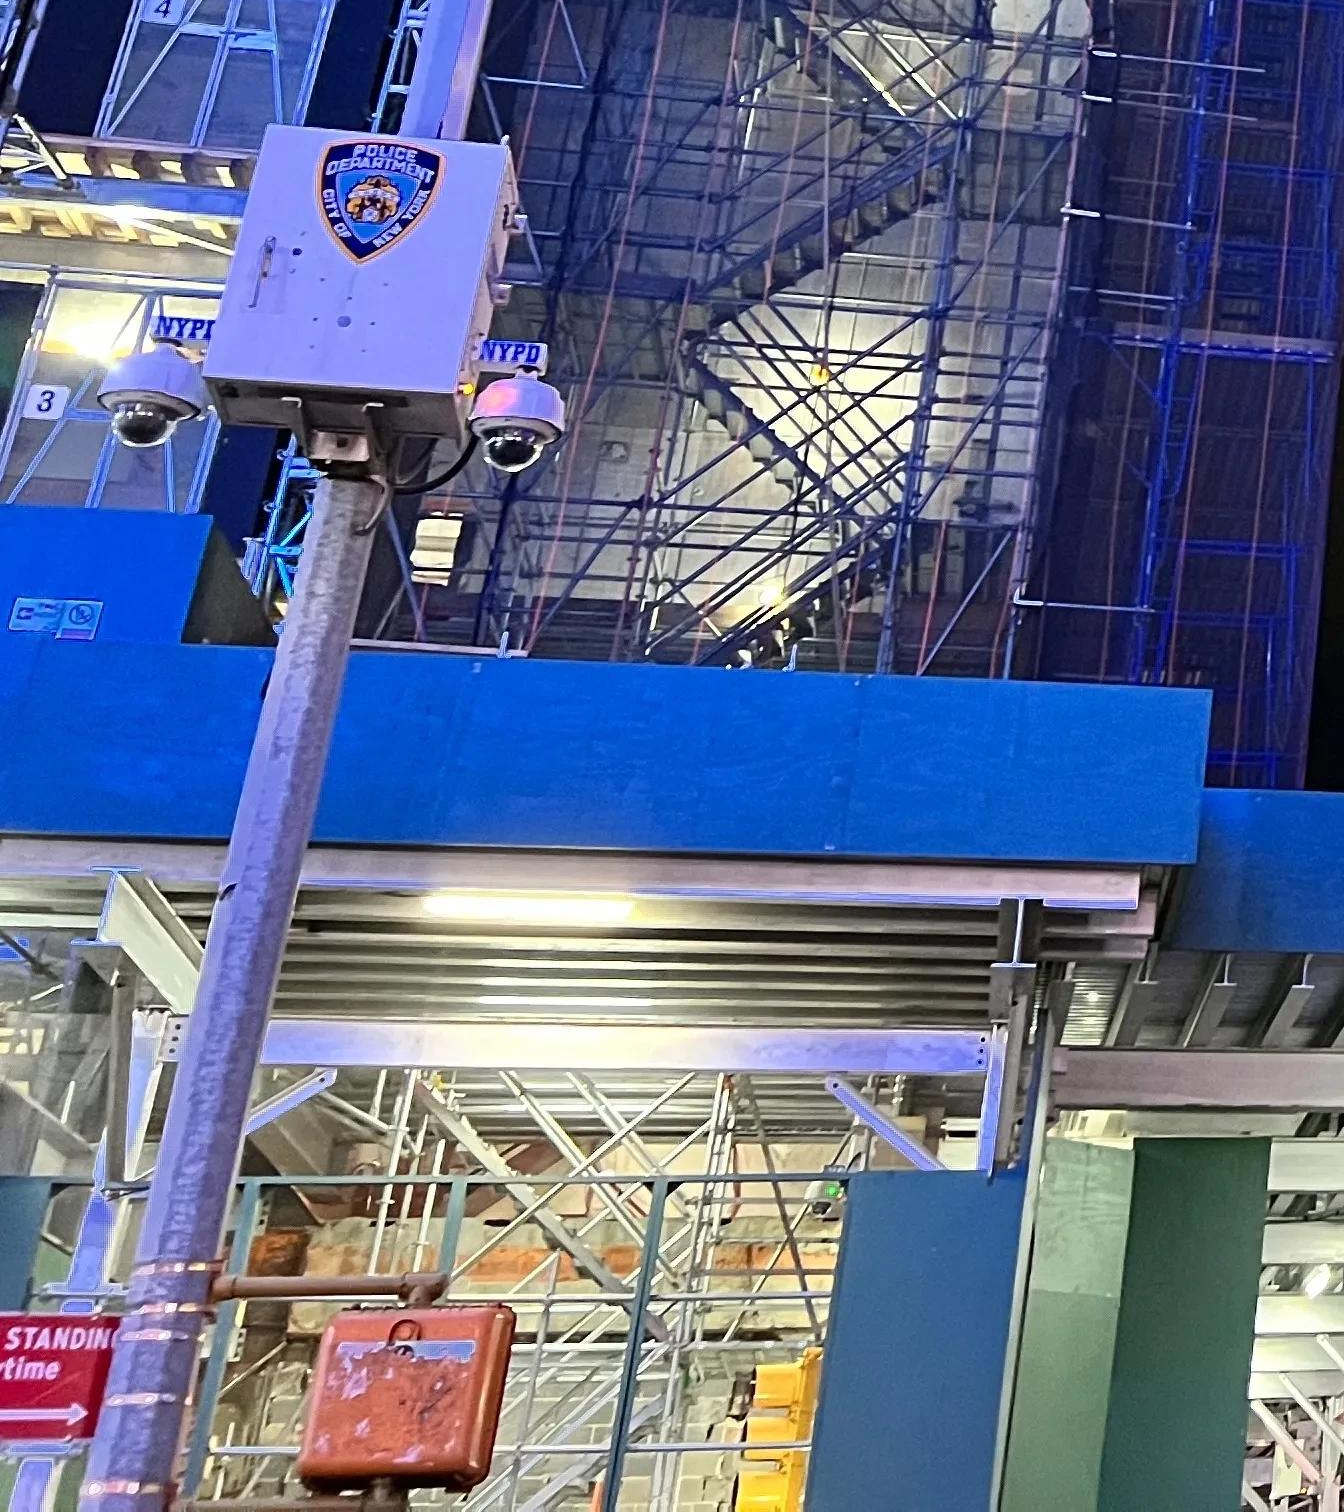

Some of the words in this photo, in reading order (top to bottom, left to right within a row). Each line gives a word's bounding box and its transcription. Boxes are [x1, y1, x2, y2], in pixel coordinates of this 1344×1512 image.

[352, 144, 418, 163] POLICE
[325, 156, 435, 184] DEPARTMENT
[322, 188, 341, 218] CITY
[333, 222, 352, 238] OF
[372, 221, 403, 248] NEW
[401, 189, 431, 220] YORK
[154, 315, 215, 340] NYP
[480, 341, 540, 365] NYPD
[37, 390, 55, 412] 3
[4, 1326, 117, 1350] STANDIN
[0, 1354, 60, 1381] time
